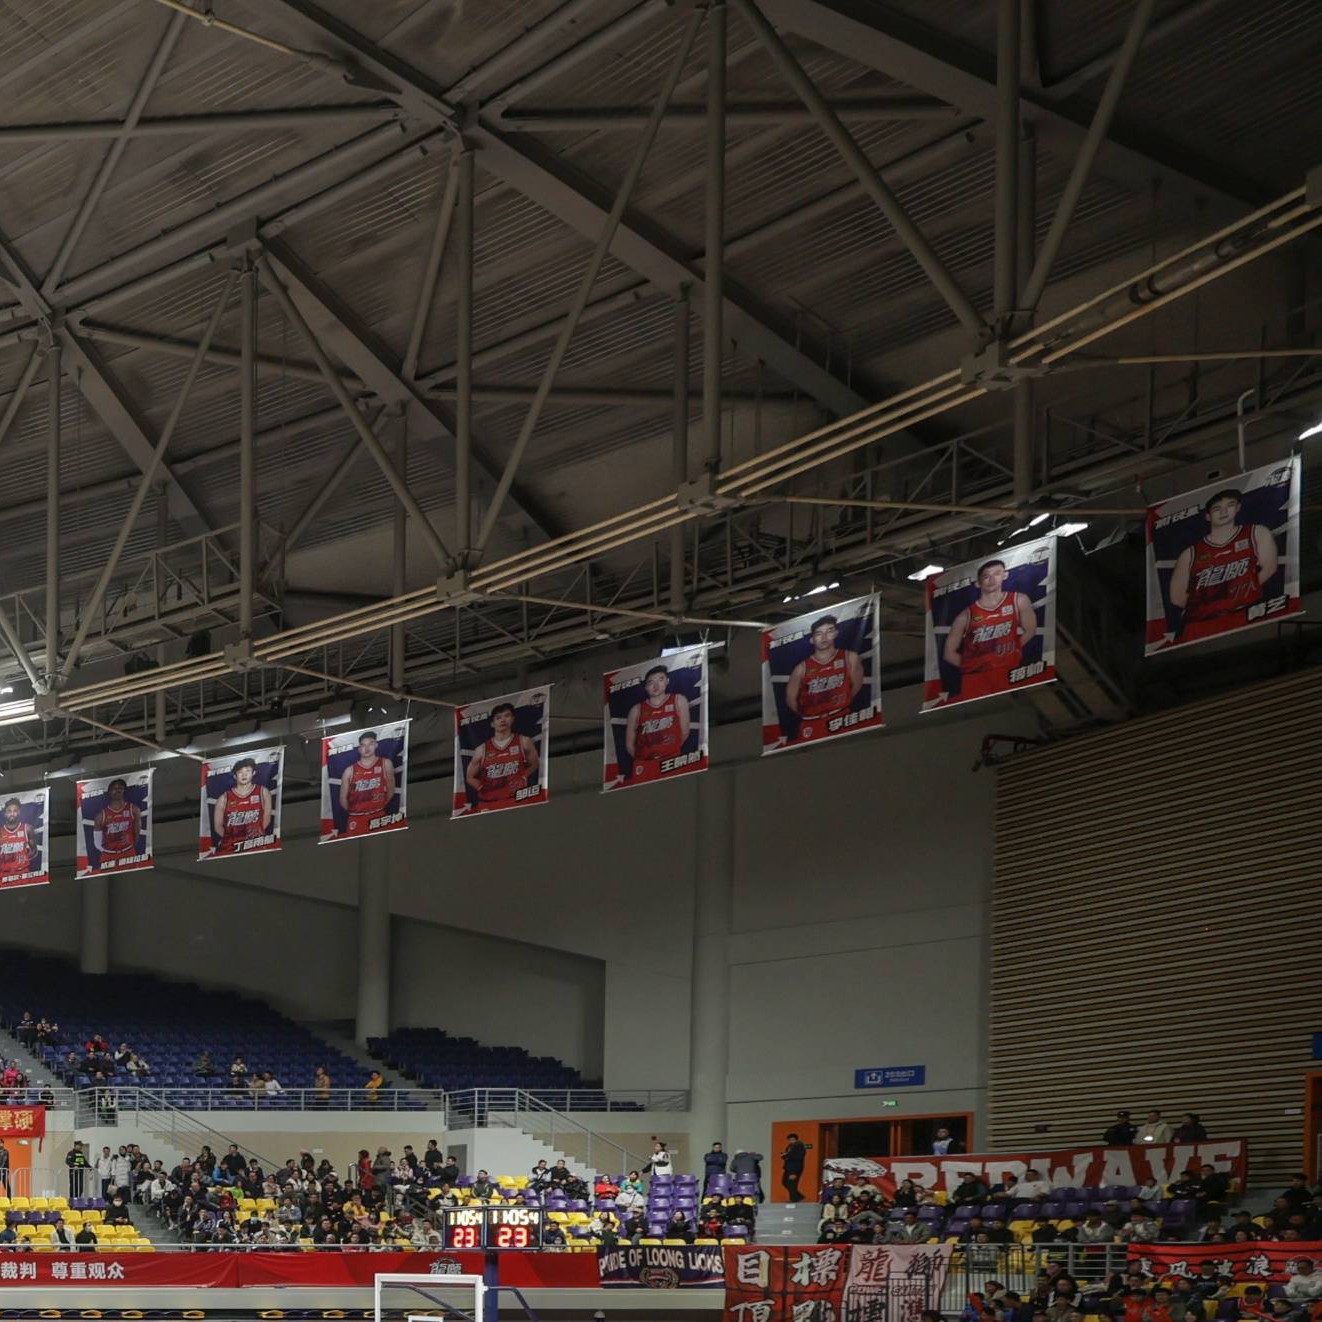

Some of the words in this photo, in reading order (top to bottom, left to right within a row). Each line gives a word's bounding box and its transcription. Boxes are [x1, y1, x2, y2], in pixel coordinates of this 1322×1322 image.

[453, 1228, 475, 1247] 23
[498, 1227, 527, 1247] 23
[629, 1249, 644, 1267] OF
[646, 1247, 685, 1269] LOONG
[737, 1248, 844, 1287] 目標
[51, 1261, 125, 1281] 尊重观众
